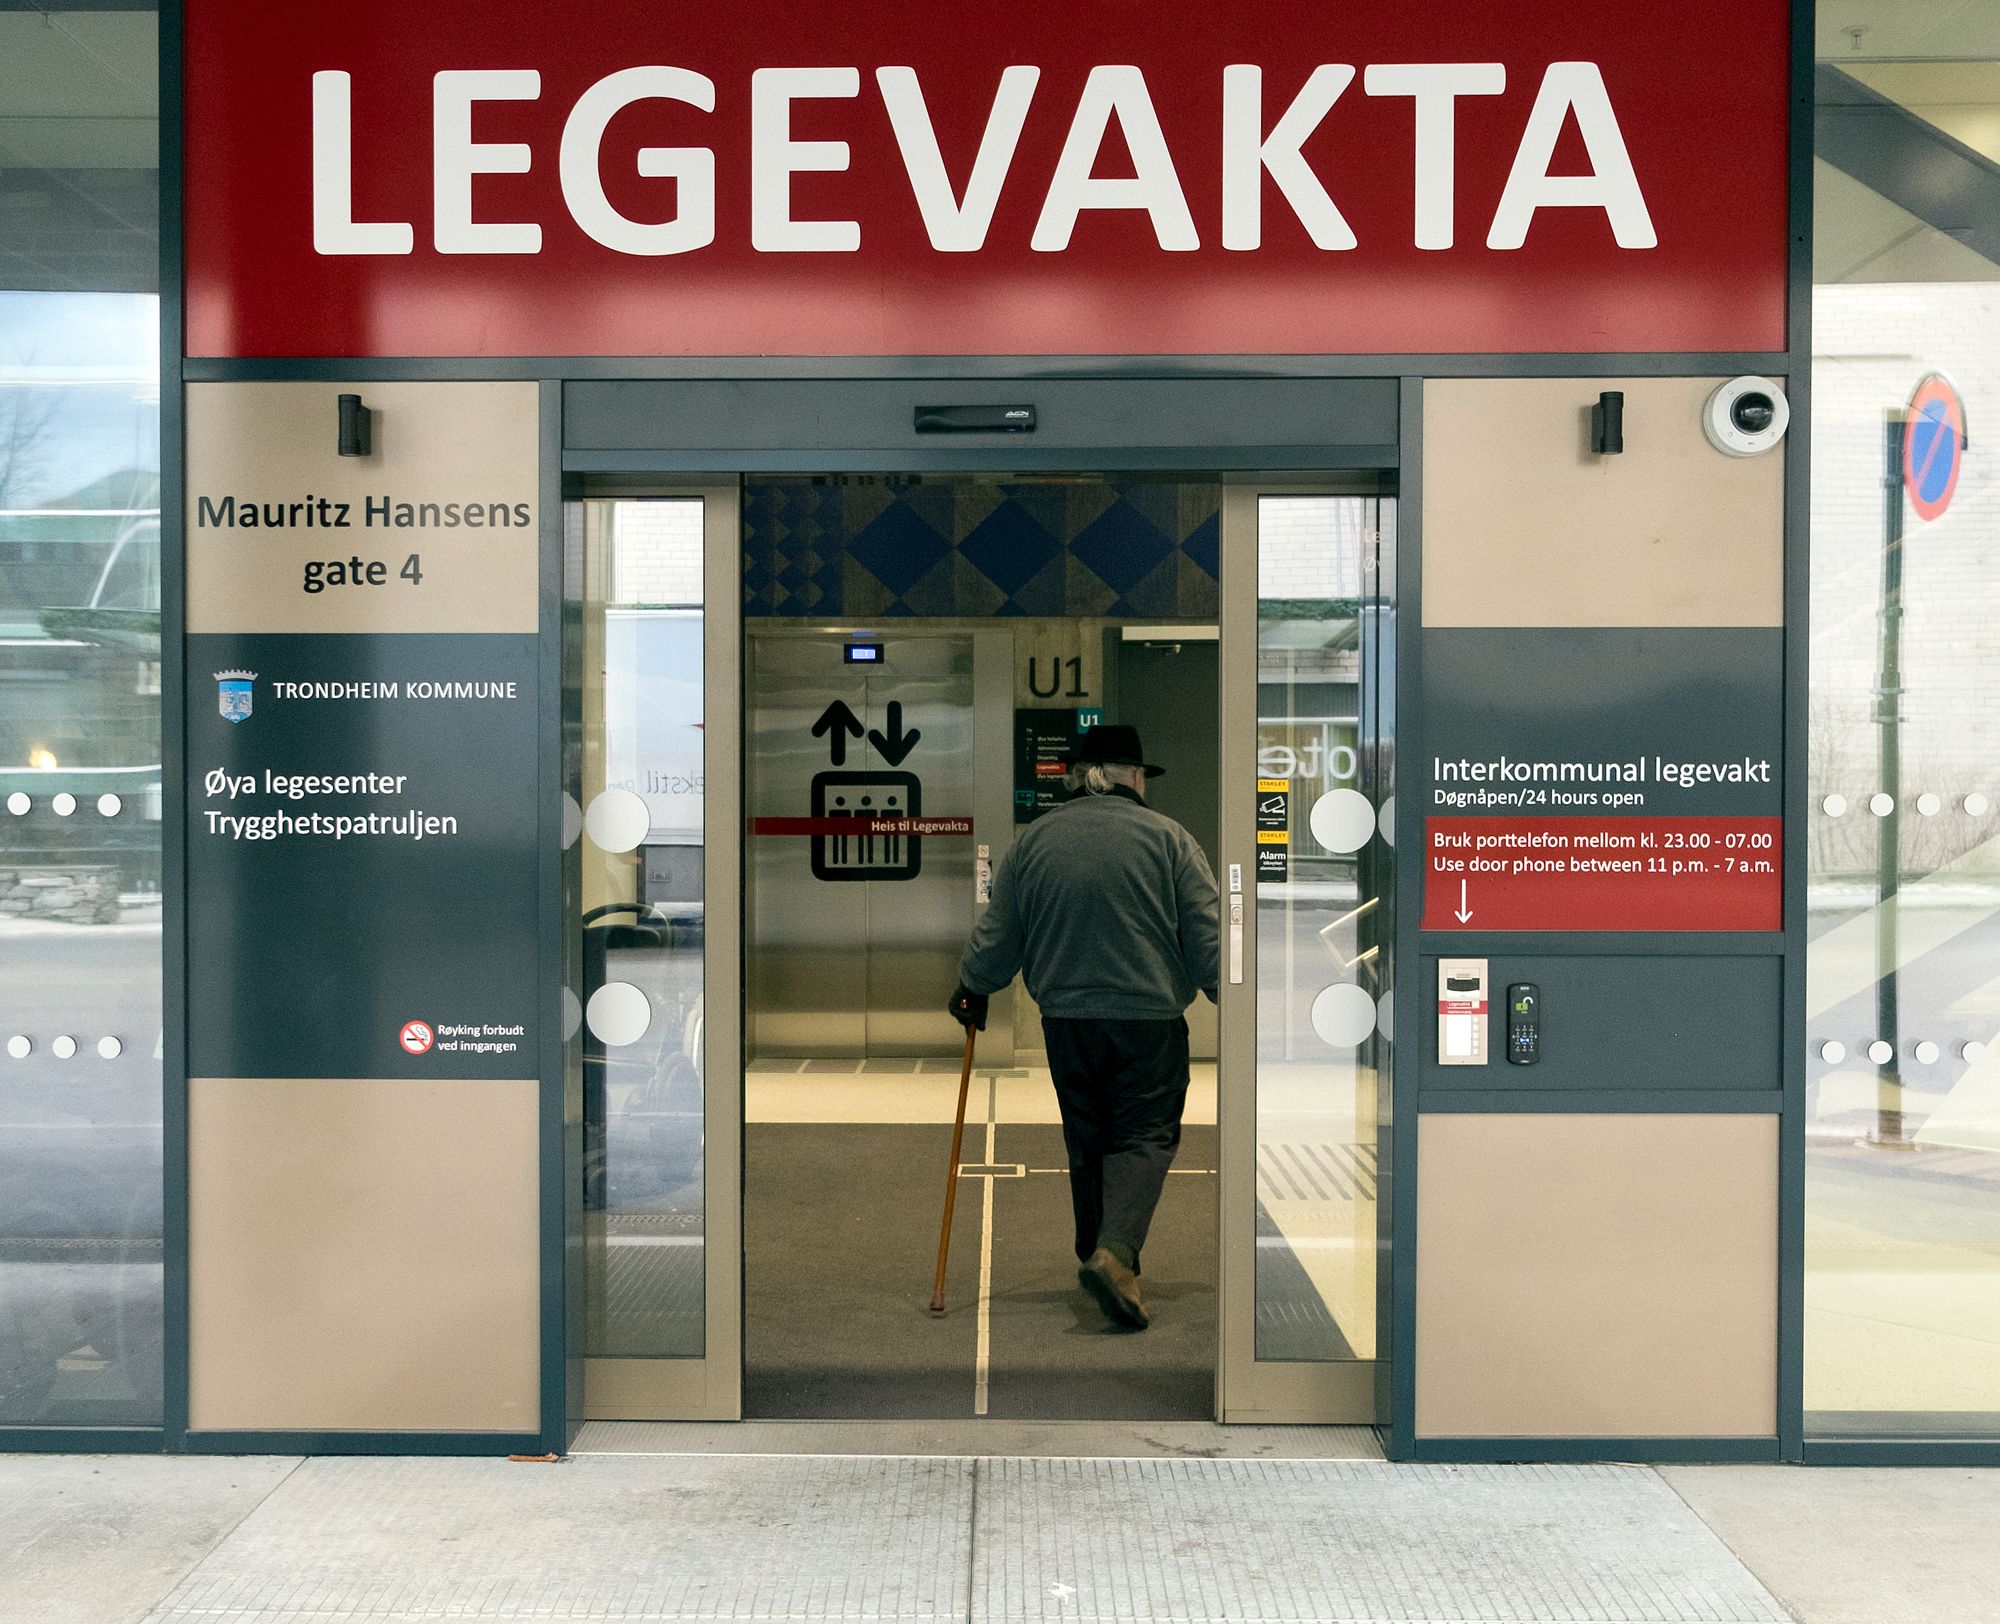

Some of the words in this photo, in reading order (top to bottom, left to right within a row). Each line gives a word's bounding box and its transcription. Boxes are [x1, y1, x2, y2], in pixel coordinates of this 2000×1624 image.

[312, 61, 1658, 257] LEGEVAKTA
[198, 494, 351, 529] Mauritz
[365, 496, 531, 529] Hansens
[304, 556, 387, 594] gate
[400, 554, 423, 586] 4
[1029, 657, 1090, 699] U1
[273, 682, 399, 700] TRONDHEIM
[406, 682, 517, 700] KOMMUNE
[1080, 714, 1099, 727] U1
[1433, 757, 1645, 782] Interkommunal
[1655, 757, 1771, 788] legevakt
[204, 767, 257, 800] Øya
[265, 769, 408, 800] legesenter
[1433, 788, 1547, 808] Døgnåpen/24
[1551, 788, 1598, 805] hours
[1602, 793, 1645, 808] open
[204, 810, 458, 841] Trygghetspatruljen
[871, 821, 896, 832] Heis
[898, 821, 910, 832] til
[912, 821, 969, 834] Legevakta
[1433, 832, 1472, 849] Bruk
[1476, 832, 1569, 852] porttelefon
[1573, 832, 1636, 849] mellom
[1640, 832, 1659, 849] kl.
[1664, 834, 1711, 849] 23.00
[1725, 833, 1773, 849] 07.00
[1259, 851, 1286, 860] Alarm
[1433, 858, 1465, 873] Use
[1469, 857, 1509, 873] door
[1513, 857, 1566, 877] phone
[1570, 857, 1642, 873] between
[1647, 858, 1668, 873] 11
[1673, 861, 1710, 876] p.m.
[1725, 858, 1735, 873] 7
[1740, 861, 1776, 873] a.m.
[438, 1024, 481, 1037] Røyking
[483, 1024, 525, 1036] forbudt
[438, 1041, 458, 1051] ved
[460, 1040, 517, 1053] inngangen
